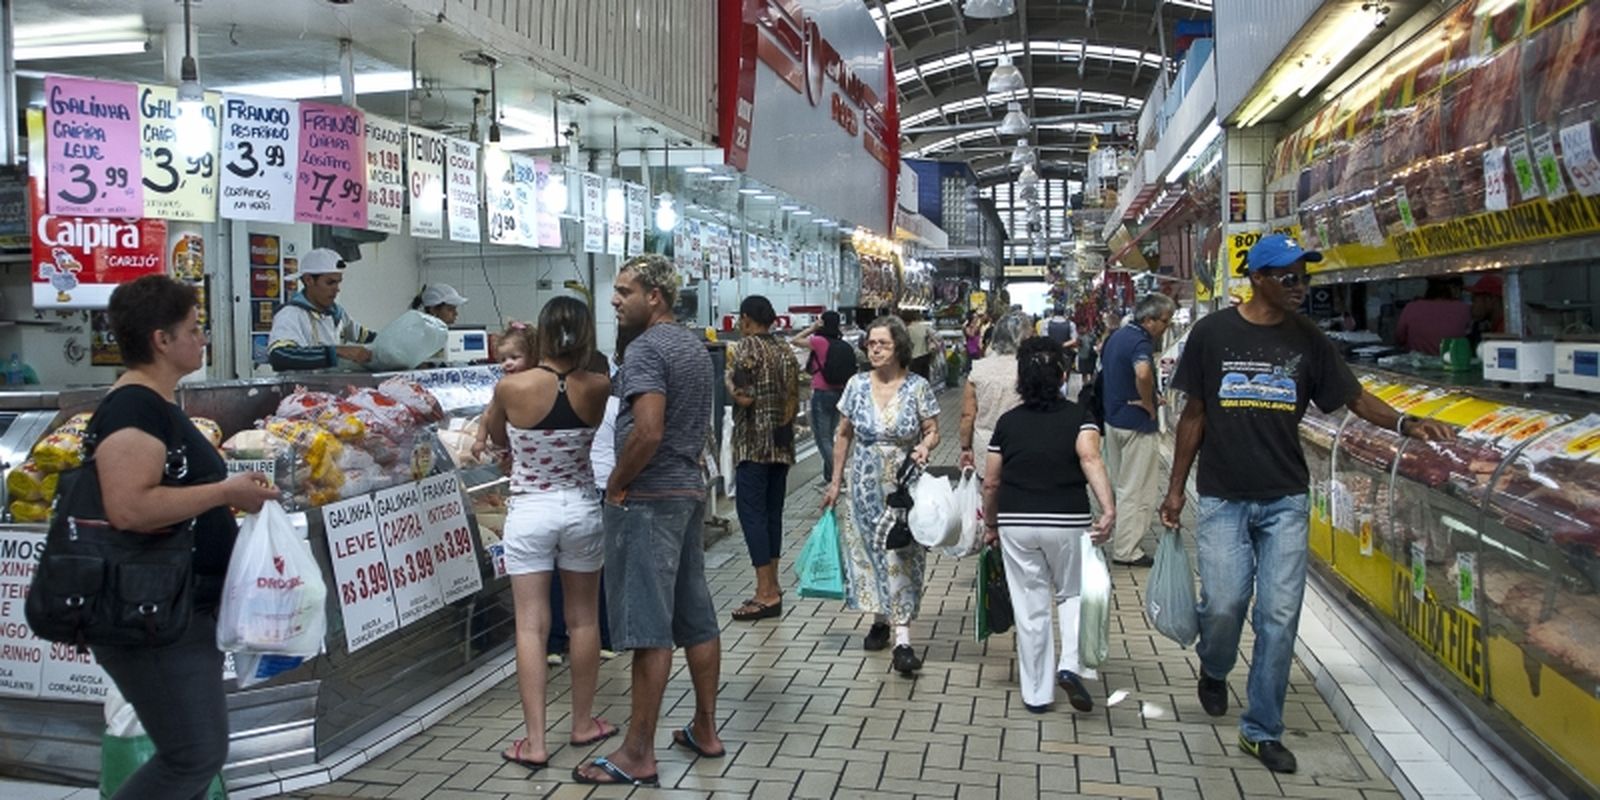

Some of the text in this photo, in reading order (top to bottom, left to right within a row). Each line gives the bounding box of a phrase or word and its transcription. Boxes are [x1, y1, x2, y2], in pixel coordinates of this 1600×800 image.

[51, 85, 130, 120] GALINHA
[227, 99, 290, 126] FRANGO
[53, 120, 106, 142] CAIPIRA
[303, 109, 361, 136] FRANGO
[64, 142, 104, 160] LEVE
[226, 141, 285, 178] 3,99
[58, 163, 128, 205] 3,99
[309, 170, 364, 212] 7,99
[37, 213, 139, 255] Caipira
[378, 489, 419, 516] GALINHA
[422, 478, 457, 502] FRANGO
[329, 501, 373, 529] GALINHA
[383, 513, 424, 547] CAIPIRA
[335, 531, 377, 559] LEVE
[434, 526, 471, 563] R$ 3,99
[342, 562, 389, 605] R$ 3,99
[393, 548, 434, 589] R$ 3,99
[2, 601, 11, 617] E
